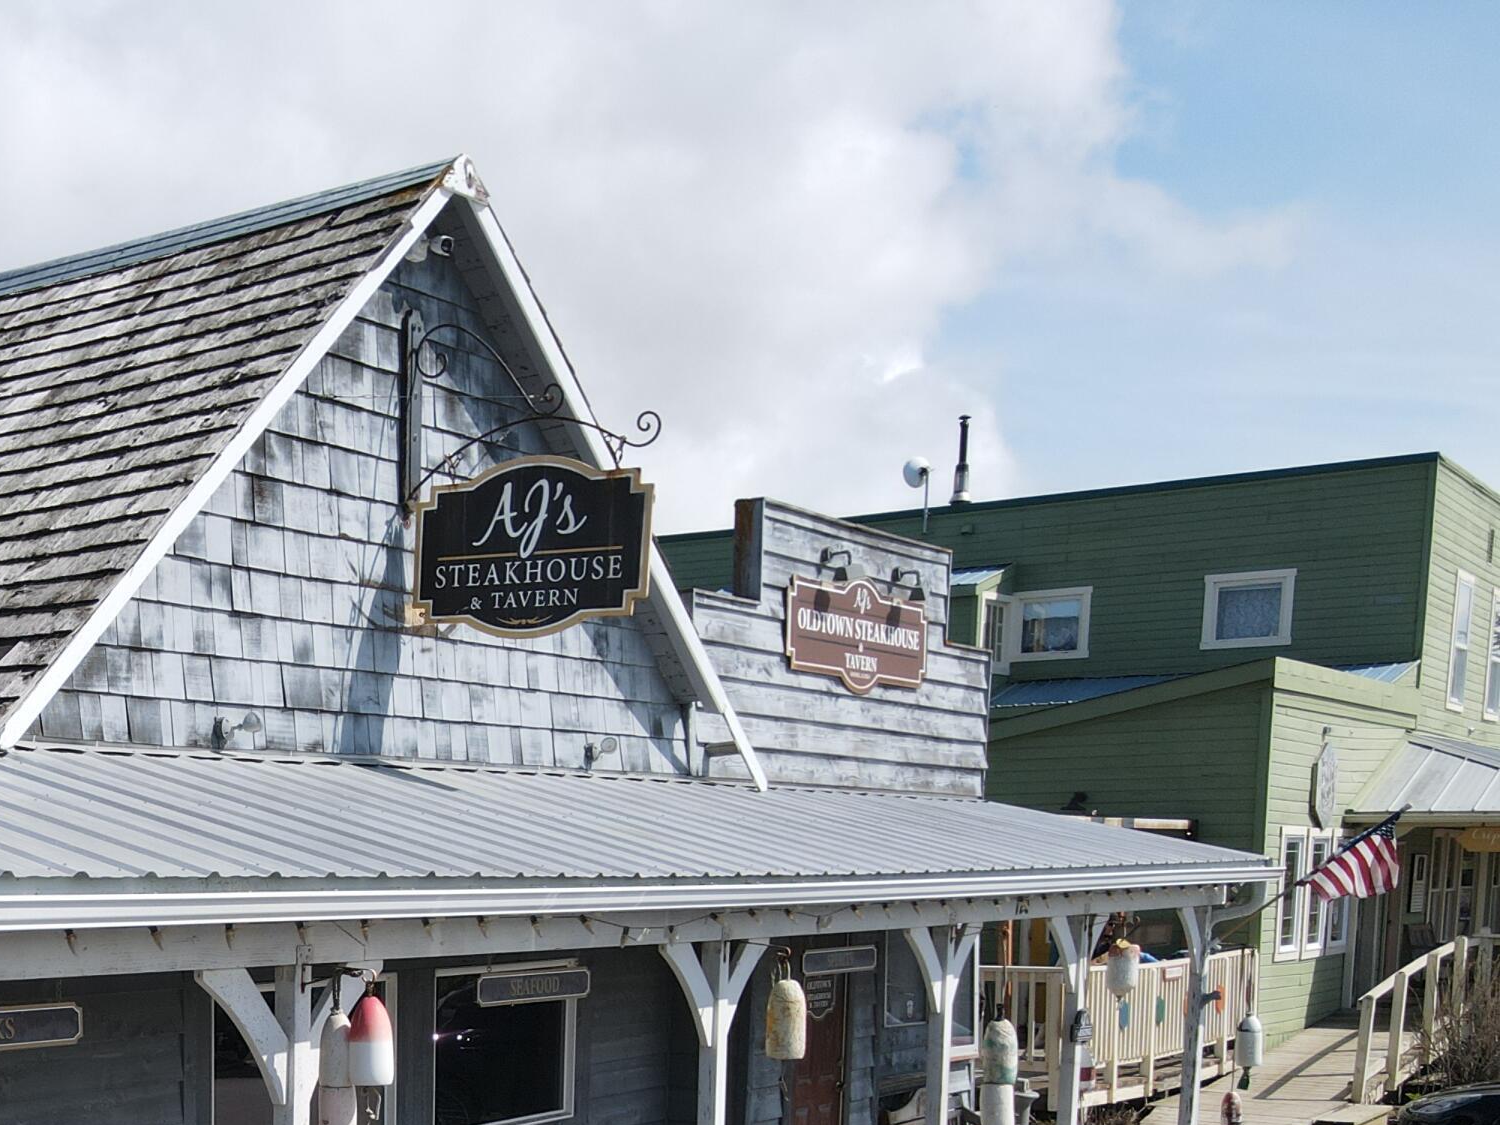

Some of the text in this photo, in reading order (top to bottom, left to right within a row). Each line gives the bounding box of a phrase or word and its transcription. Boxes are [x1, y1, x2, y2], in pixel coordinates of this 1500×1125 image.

[472, 478, 588, 559] AJ's
[434, 555, 623, 589] STEAKHOUSE
[470, 588, 579, 610] & TAVERN
[797, 607, 920, 651] OLDTOWN STEAKHOUSE
[844, 653, 877, 672] TAVERN
[509, 977, 560, 995] SEAFOOD
